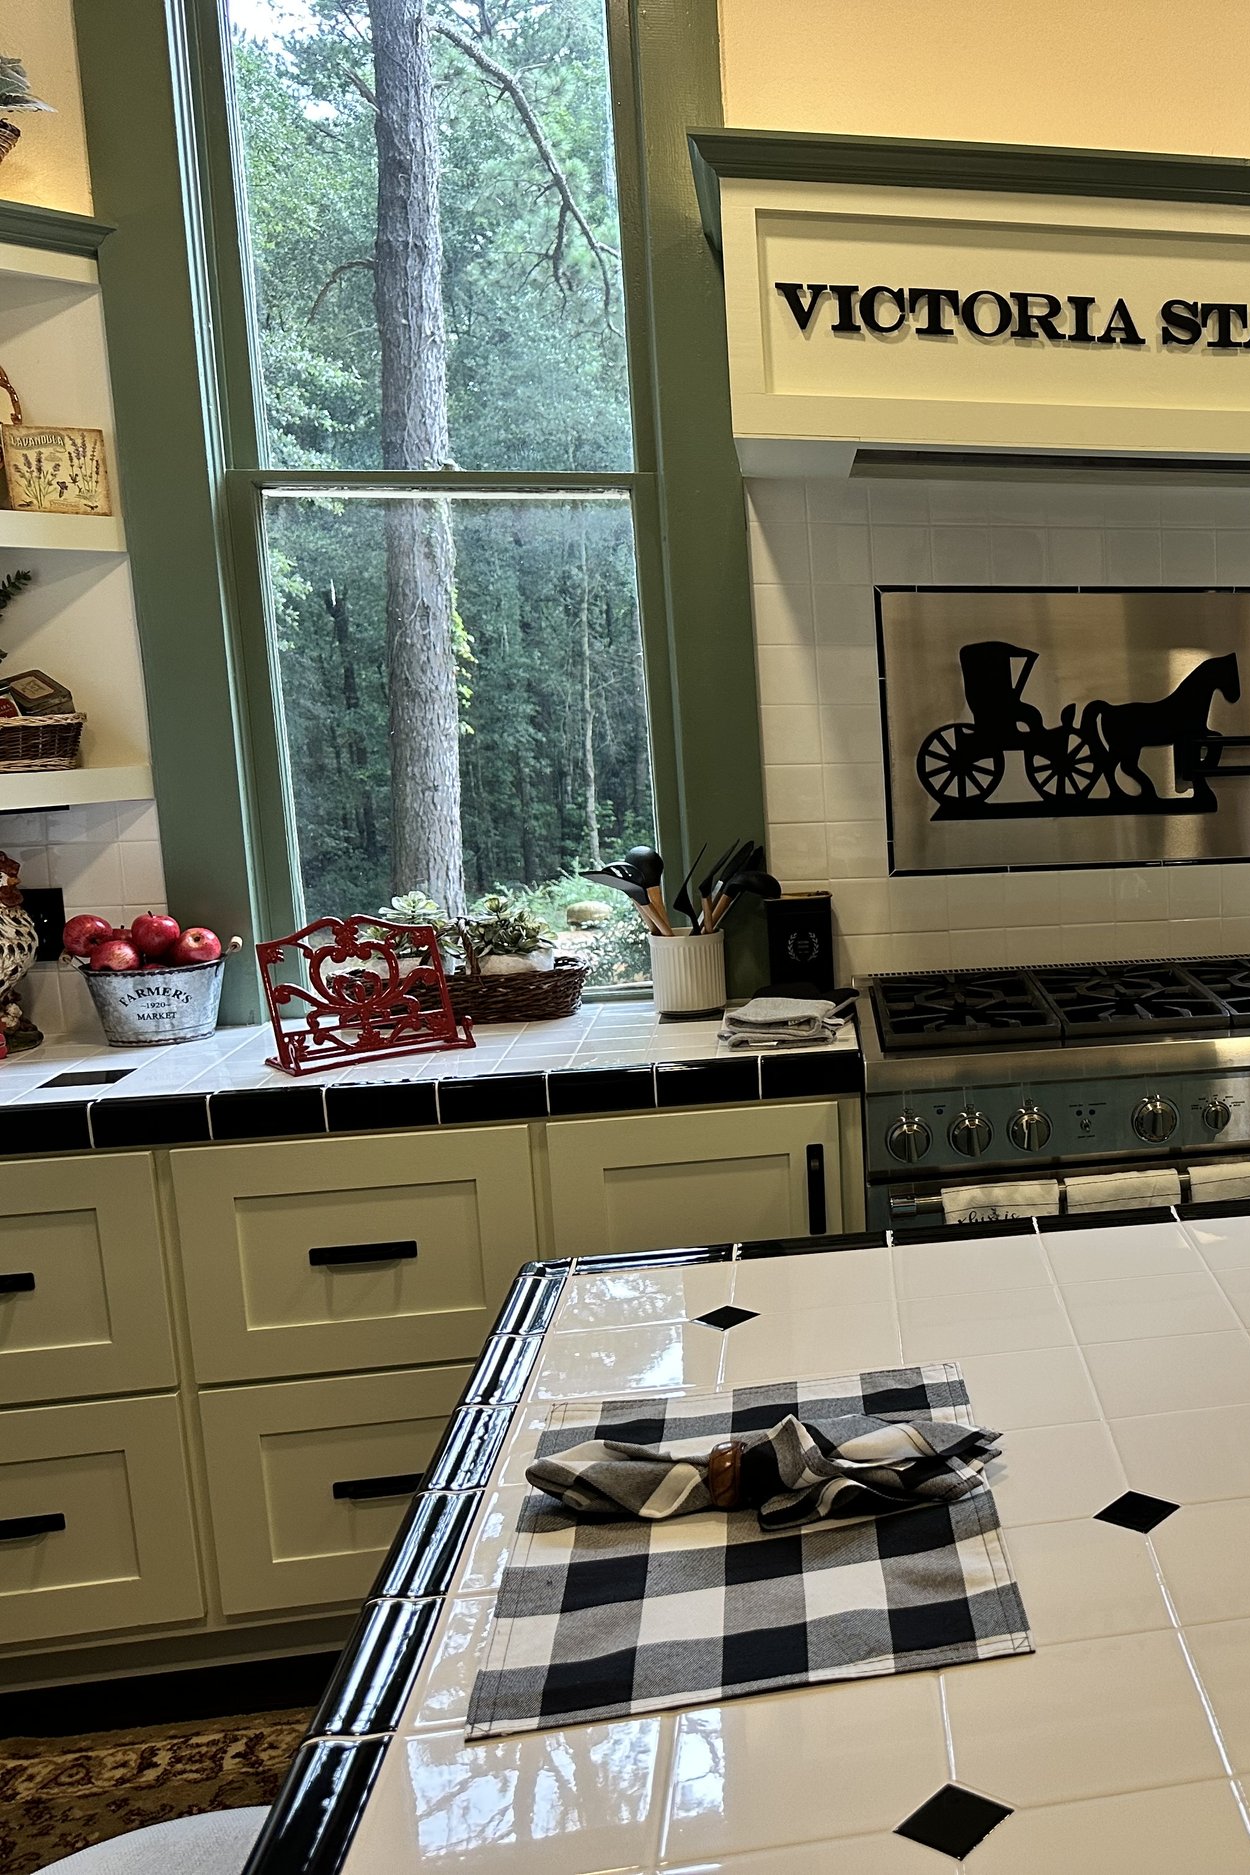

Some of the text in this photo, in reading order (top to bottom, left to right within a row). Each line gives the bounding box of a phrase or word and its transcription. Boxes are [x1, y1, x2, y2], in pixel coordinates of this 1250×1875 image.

[775, 282, 1145, 345] VICTORIA
[119, 987, 193, 1008] FARMER'S
[137, 1011, 177, 1021] MARKET
